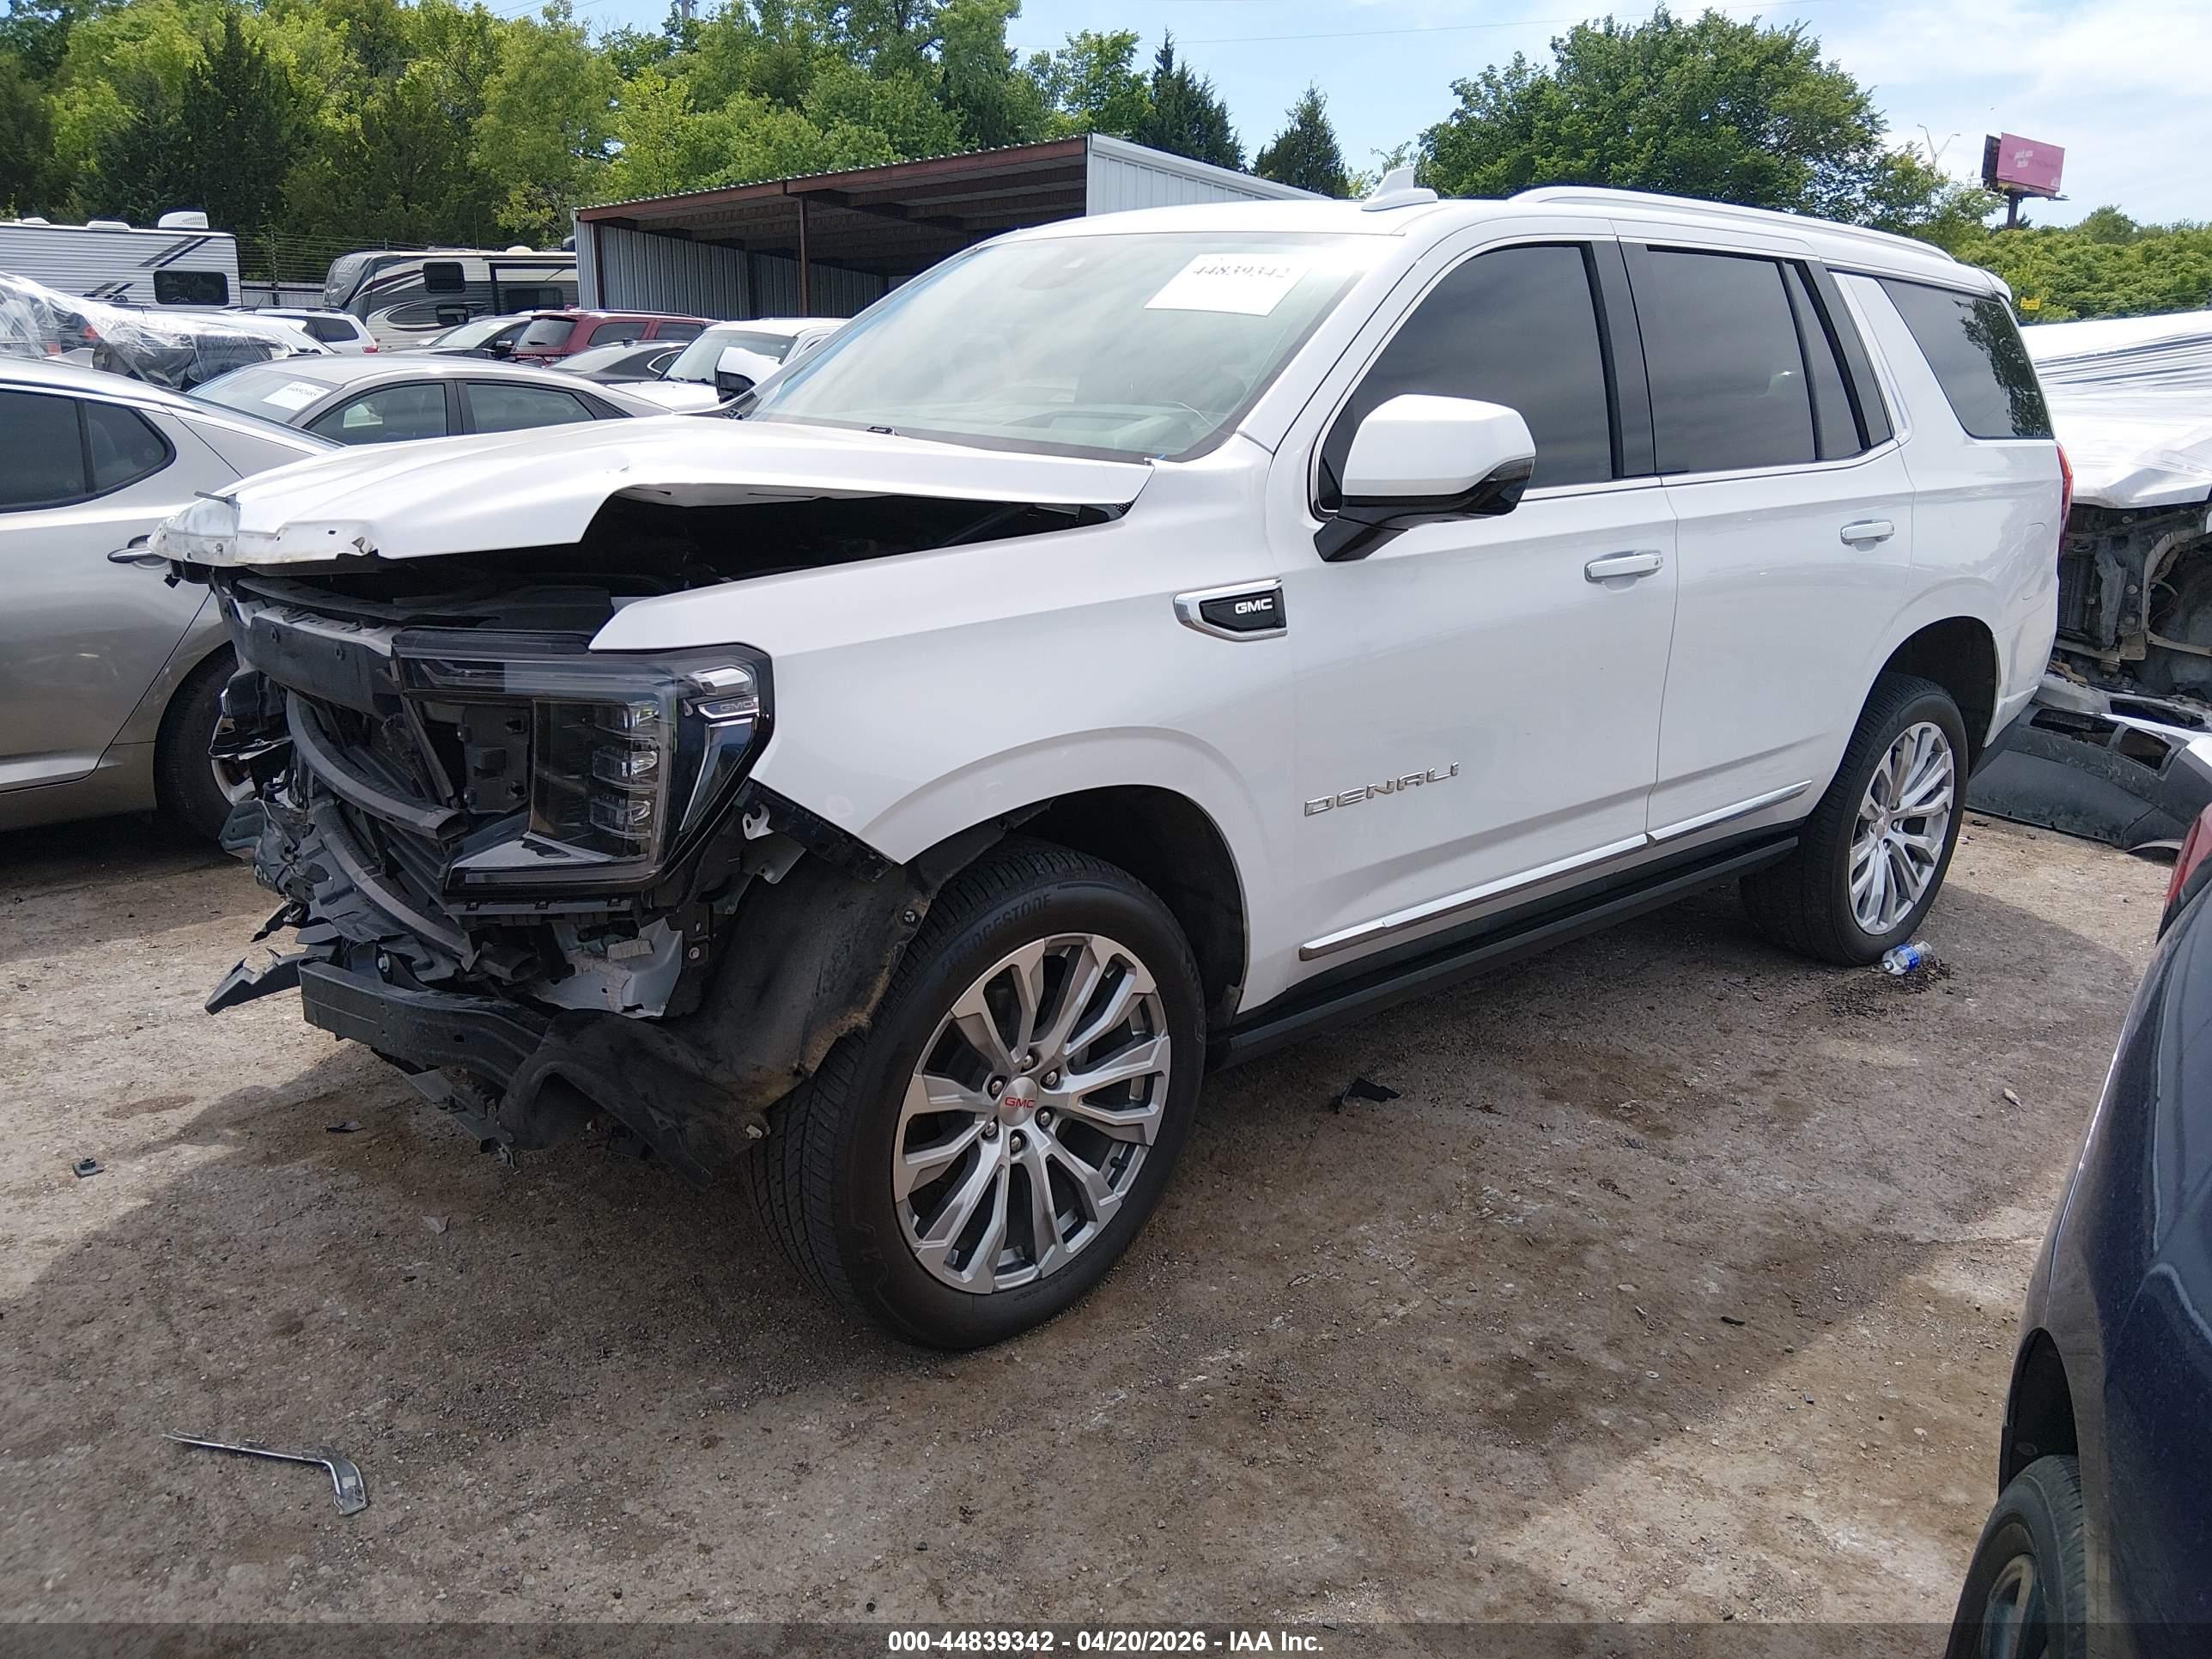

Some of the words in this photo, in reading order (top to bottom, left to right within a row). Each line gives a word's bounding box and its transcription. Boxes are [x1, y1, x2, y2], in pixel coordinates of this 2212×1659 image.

[1235, 598, 1273, 615] GMC
[720, 701, 754, 712] GMC
[1304, 762, 1459, 817] DENALI
[941, 893, 1053, 977] DGESTONE
[1004, 1097, 1036, 1109] GMC
